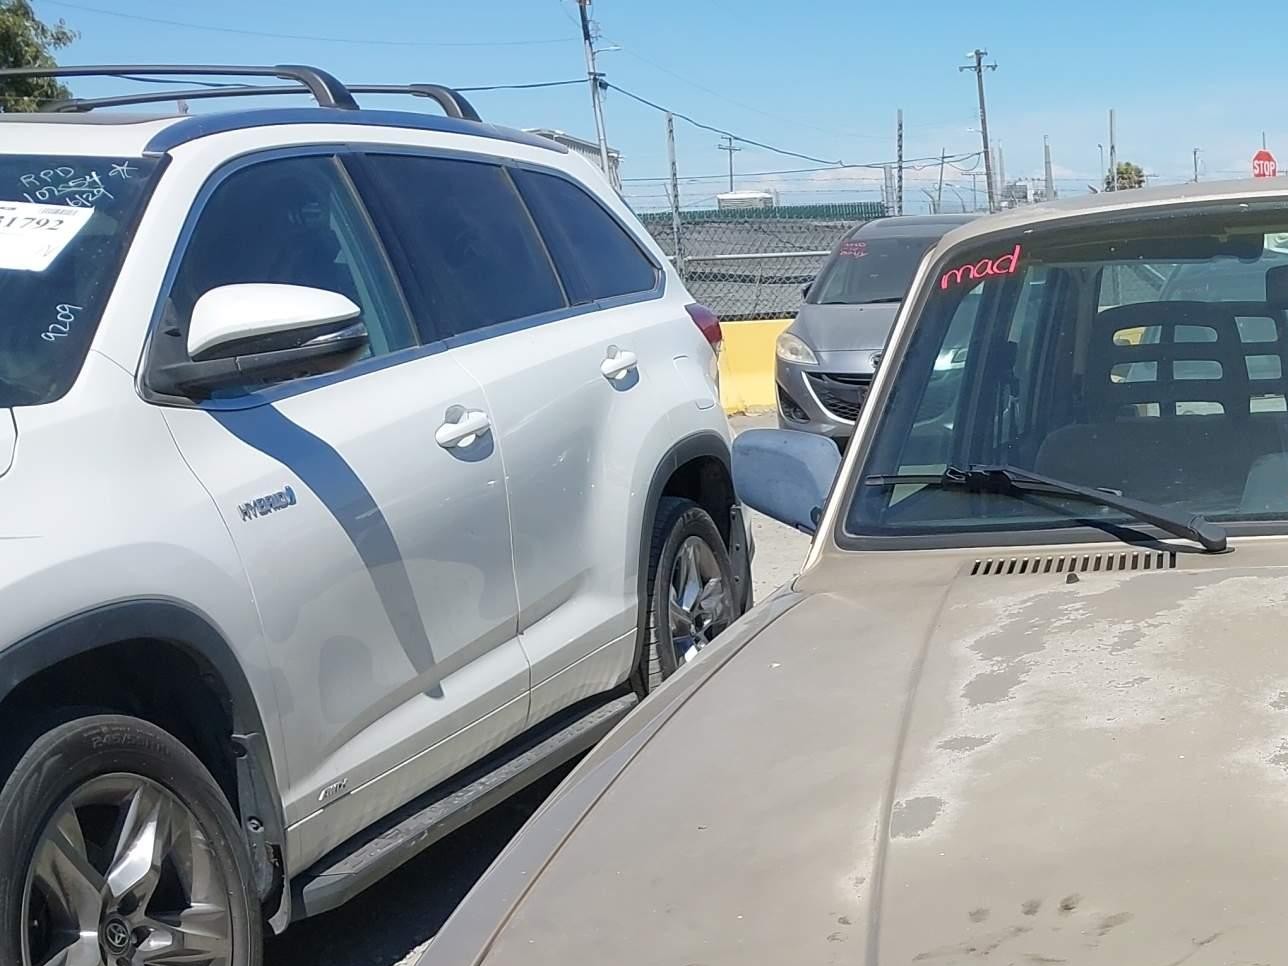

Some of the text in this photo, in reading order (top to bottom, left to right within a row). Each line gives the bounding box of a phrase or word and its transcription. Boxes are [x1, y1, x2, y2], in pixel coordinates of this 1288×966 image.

[20, 166, 75, 187] RPD
[1253, 160, 1276, 177] STOP
[941, 244, 1021, 290] mad
[40, 303, 83, 341] 9209
[238, 491, 289, 522] HYBRID
